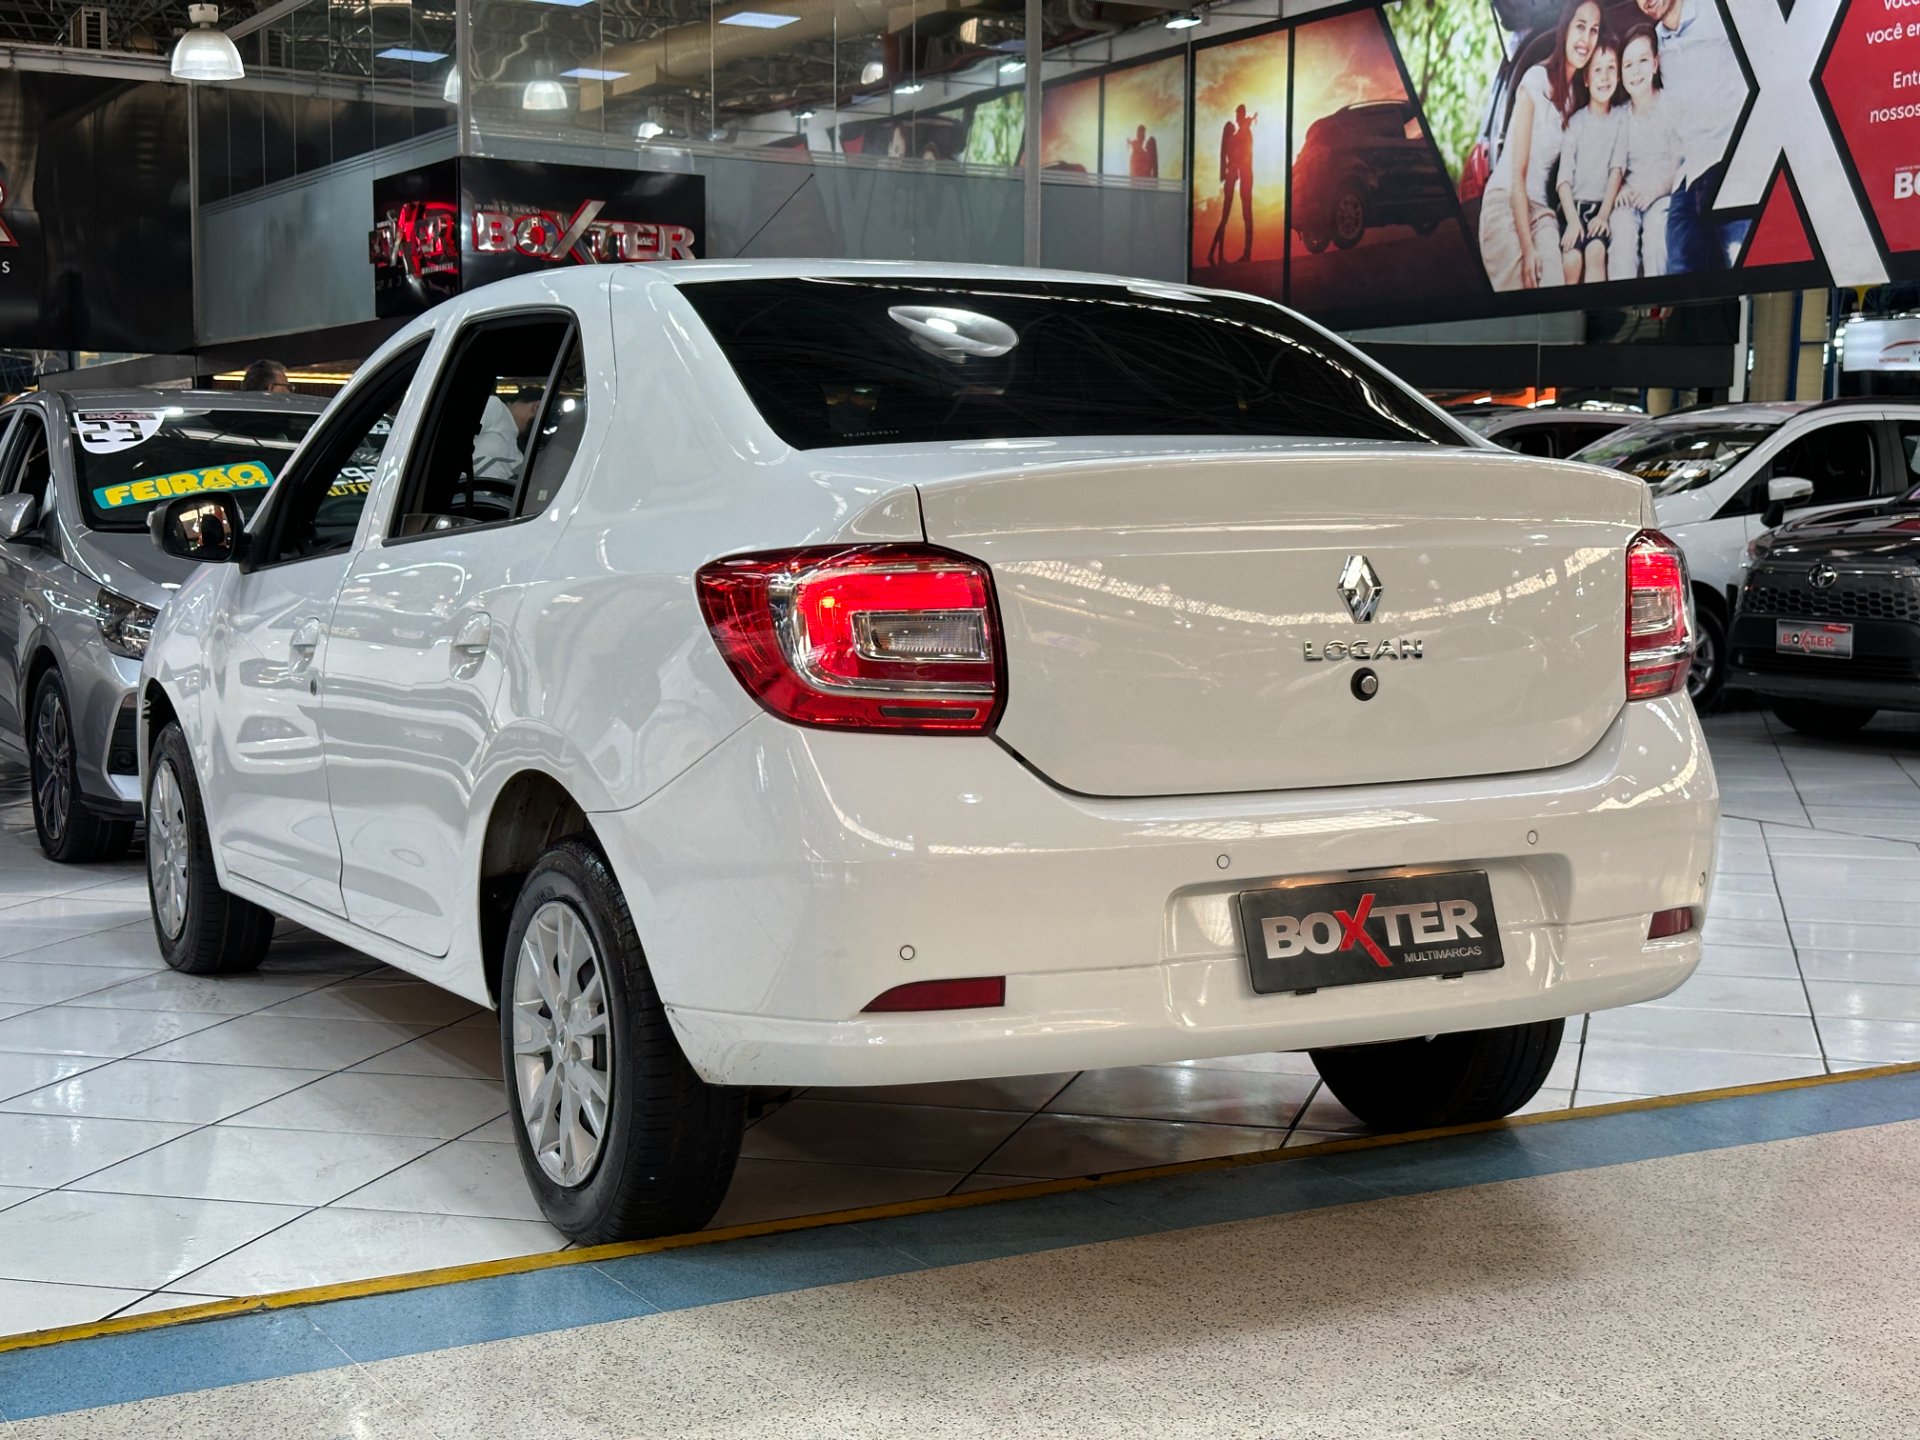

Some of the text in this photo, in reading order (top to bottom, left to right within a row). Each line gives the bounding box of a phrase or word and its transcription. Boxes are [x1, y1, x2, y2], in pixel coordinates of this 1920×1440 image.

[1866, 22, 1902, 45] você
[1893, 70, 1920, 89] Ent
[473, 199, 697, 264] BOXTER
[82, 421, 144, 443] 23
[104, 463, 267, 506] FEIRÃO
[1304, 639, 1424, 662] LOGAN
[1781, 629, 1836, 654] BOXTER
[1261, 893, 1483, 967] BOXTER
[1404, 945, 1482, 963] MULTIMARCAS
